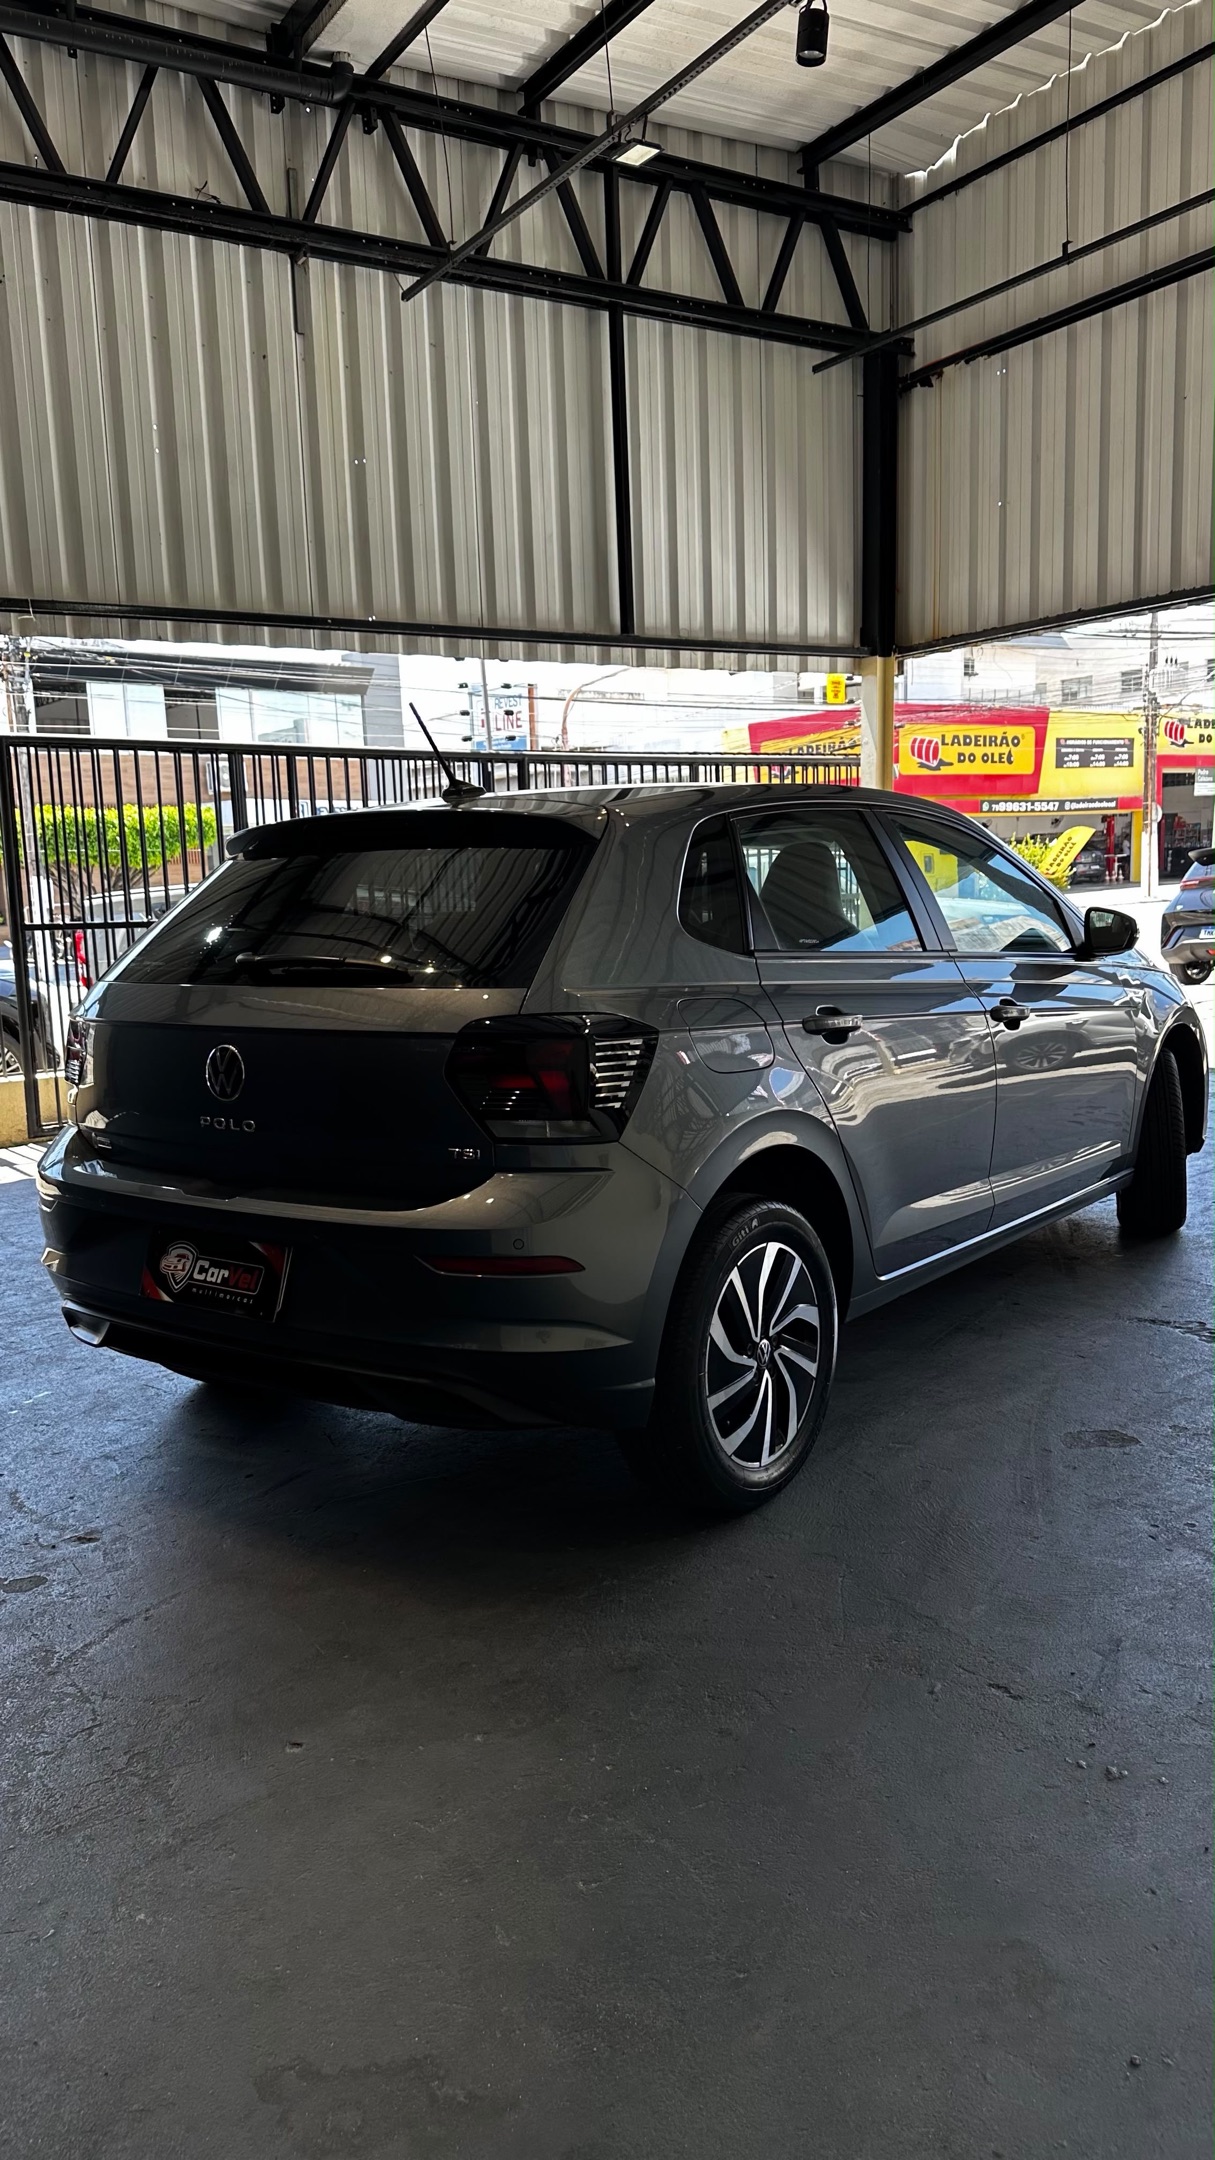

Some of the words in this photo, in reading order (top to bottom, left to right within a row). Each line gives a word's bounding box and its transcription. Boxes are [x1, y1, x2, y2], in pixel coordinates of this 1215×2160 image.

[495, 710, 523, 731] LINE
[941, 731, 1021, 748] LADEIRÃO
[1199, 733, 1213, 744] DO
[957, 752, 976, 763] DO
[200, 1116, 255, 1132] POLO
[448, 1148, 480, 1160] TSI
[192, 1259, 260, 1290] CarVel
[191, 1287, 254, 1304] multimarcas
